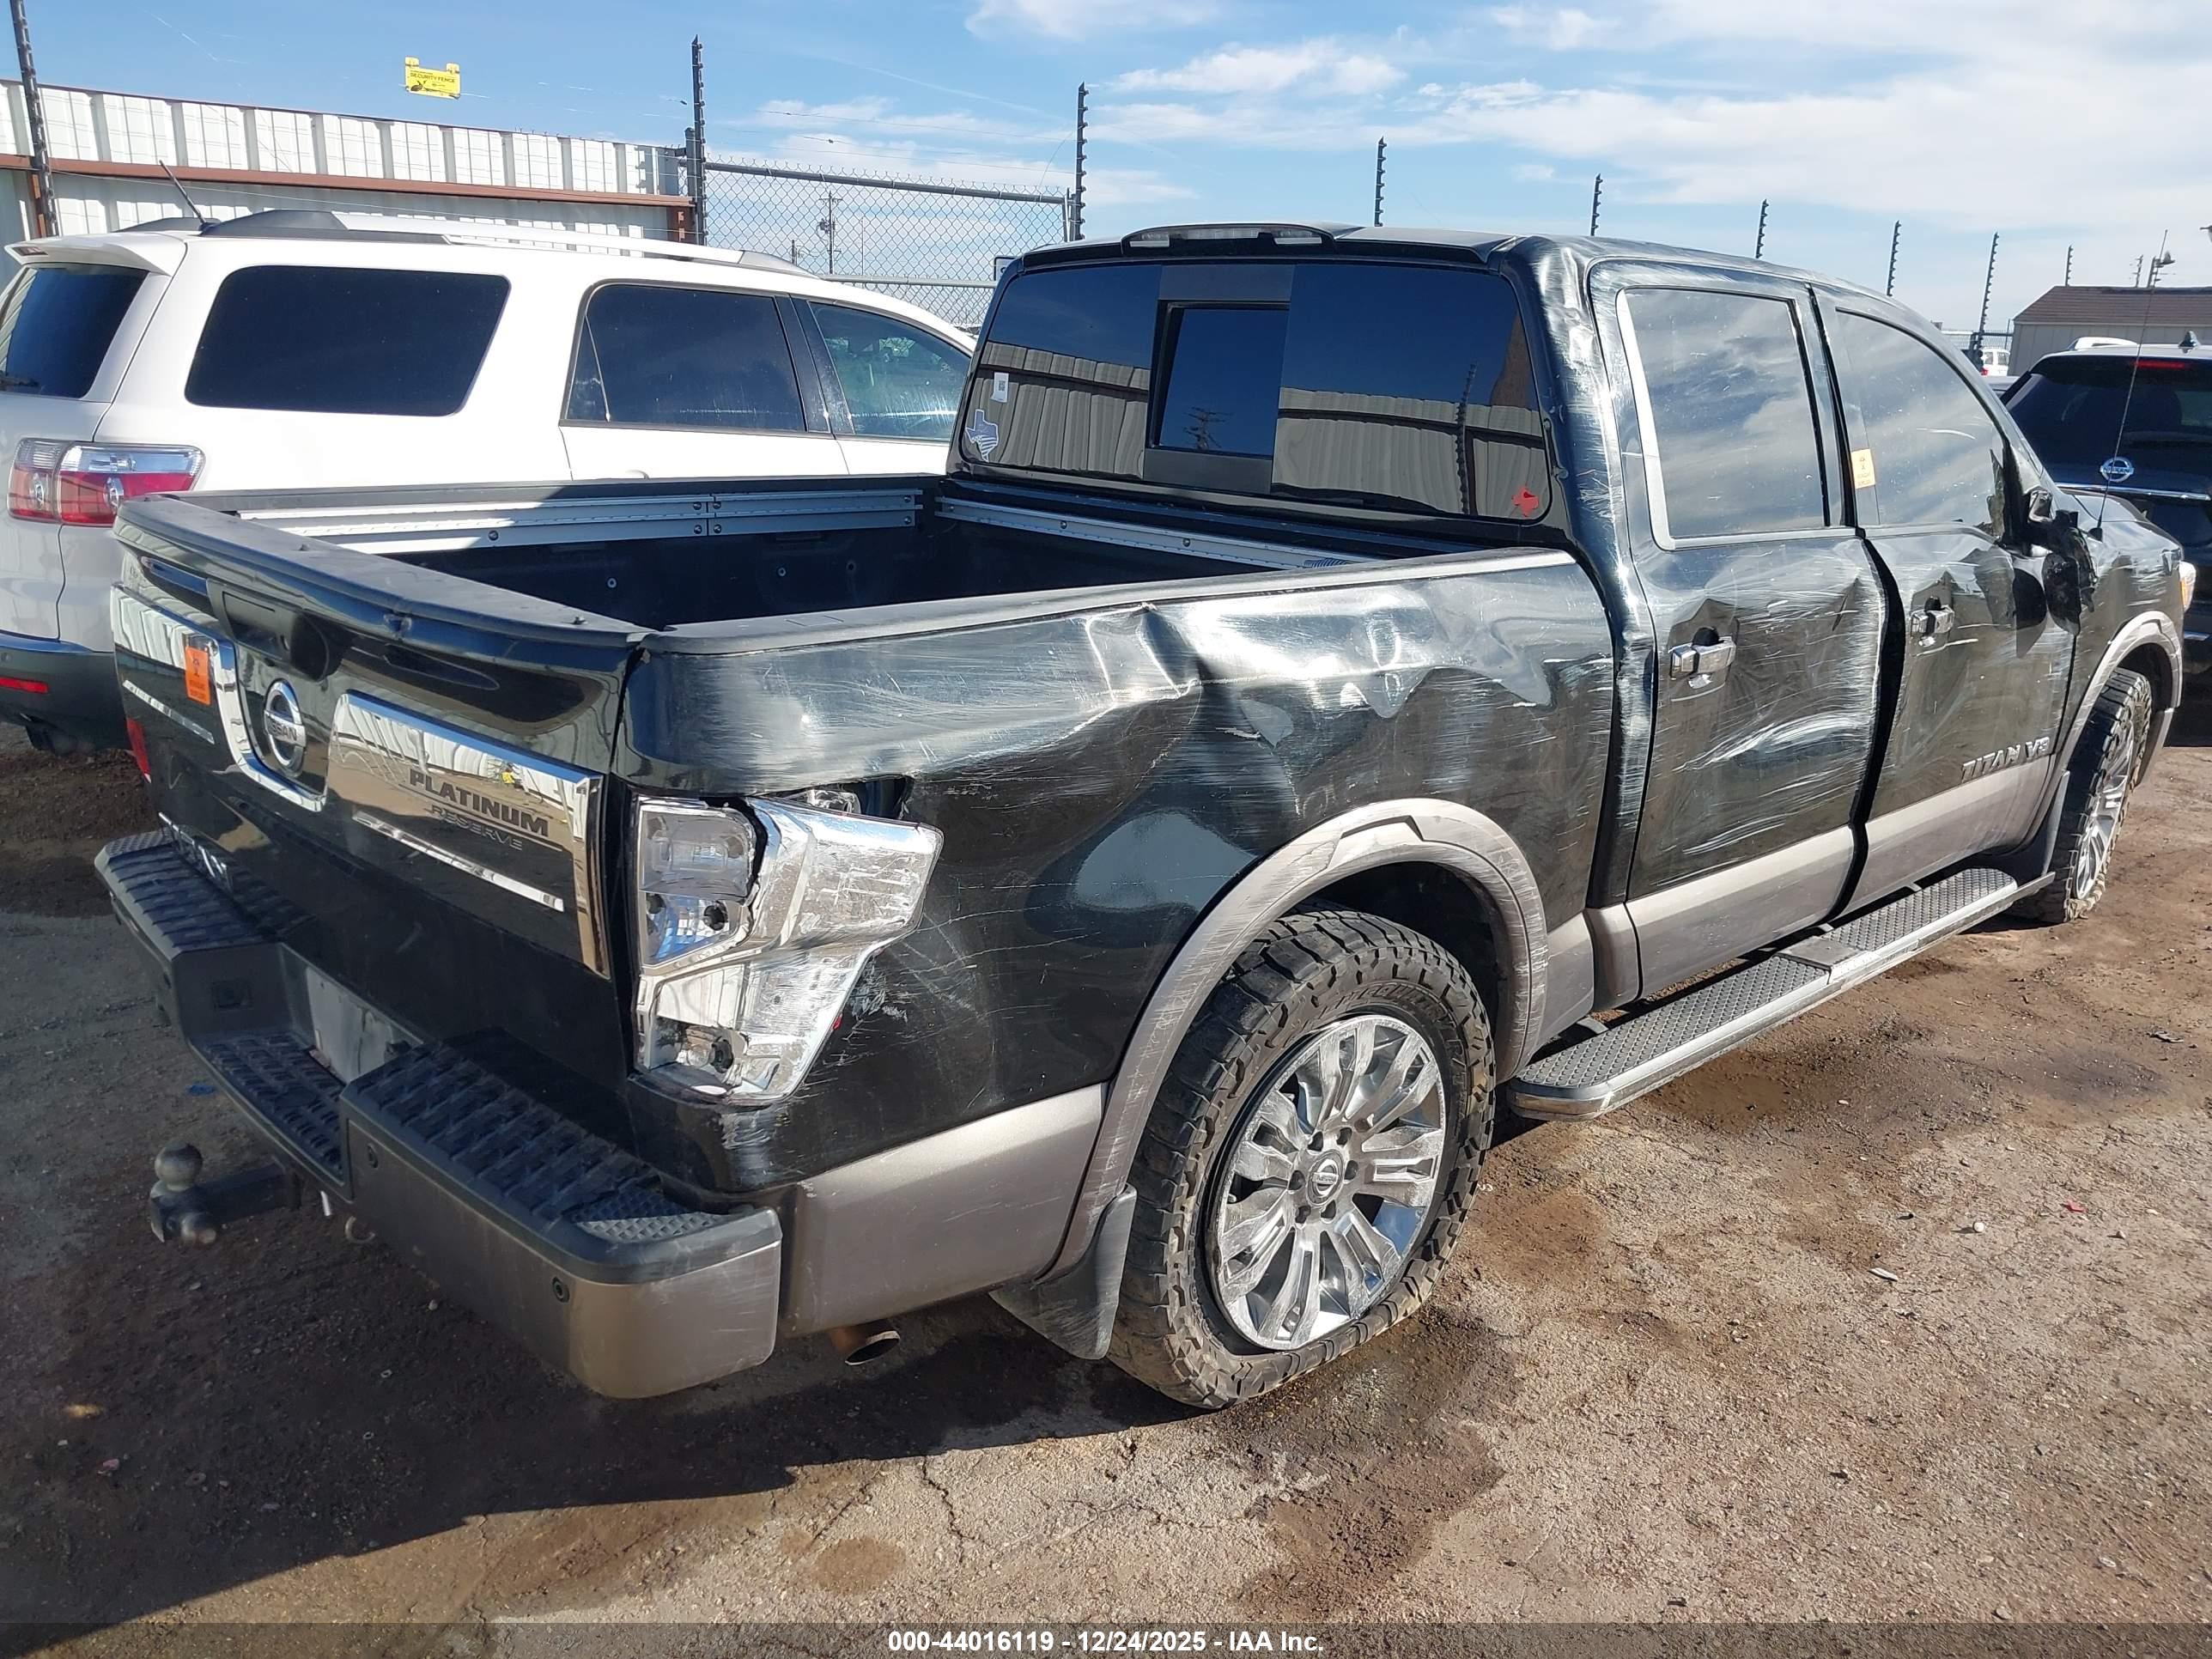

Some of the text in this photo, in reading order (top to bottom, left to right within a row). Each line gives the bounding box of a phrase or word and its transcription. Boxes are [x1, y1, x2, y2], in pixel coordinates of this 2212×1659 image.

[1962, 744, 2021, 784] TITAN
[410, 769, 550, 837] PLATINUM
[430, 804, 523, 851] RESERVE
